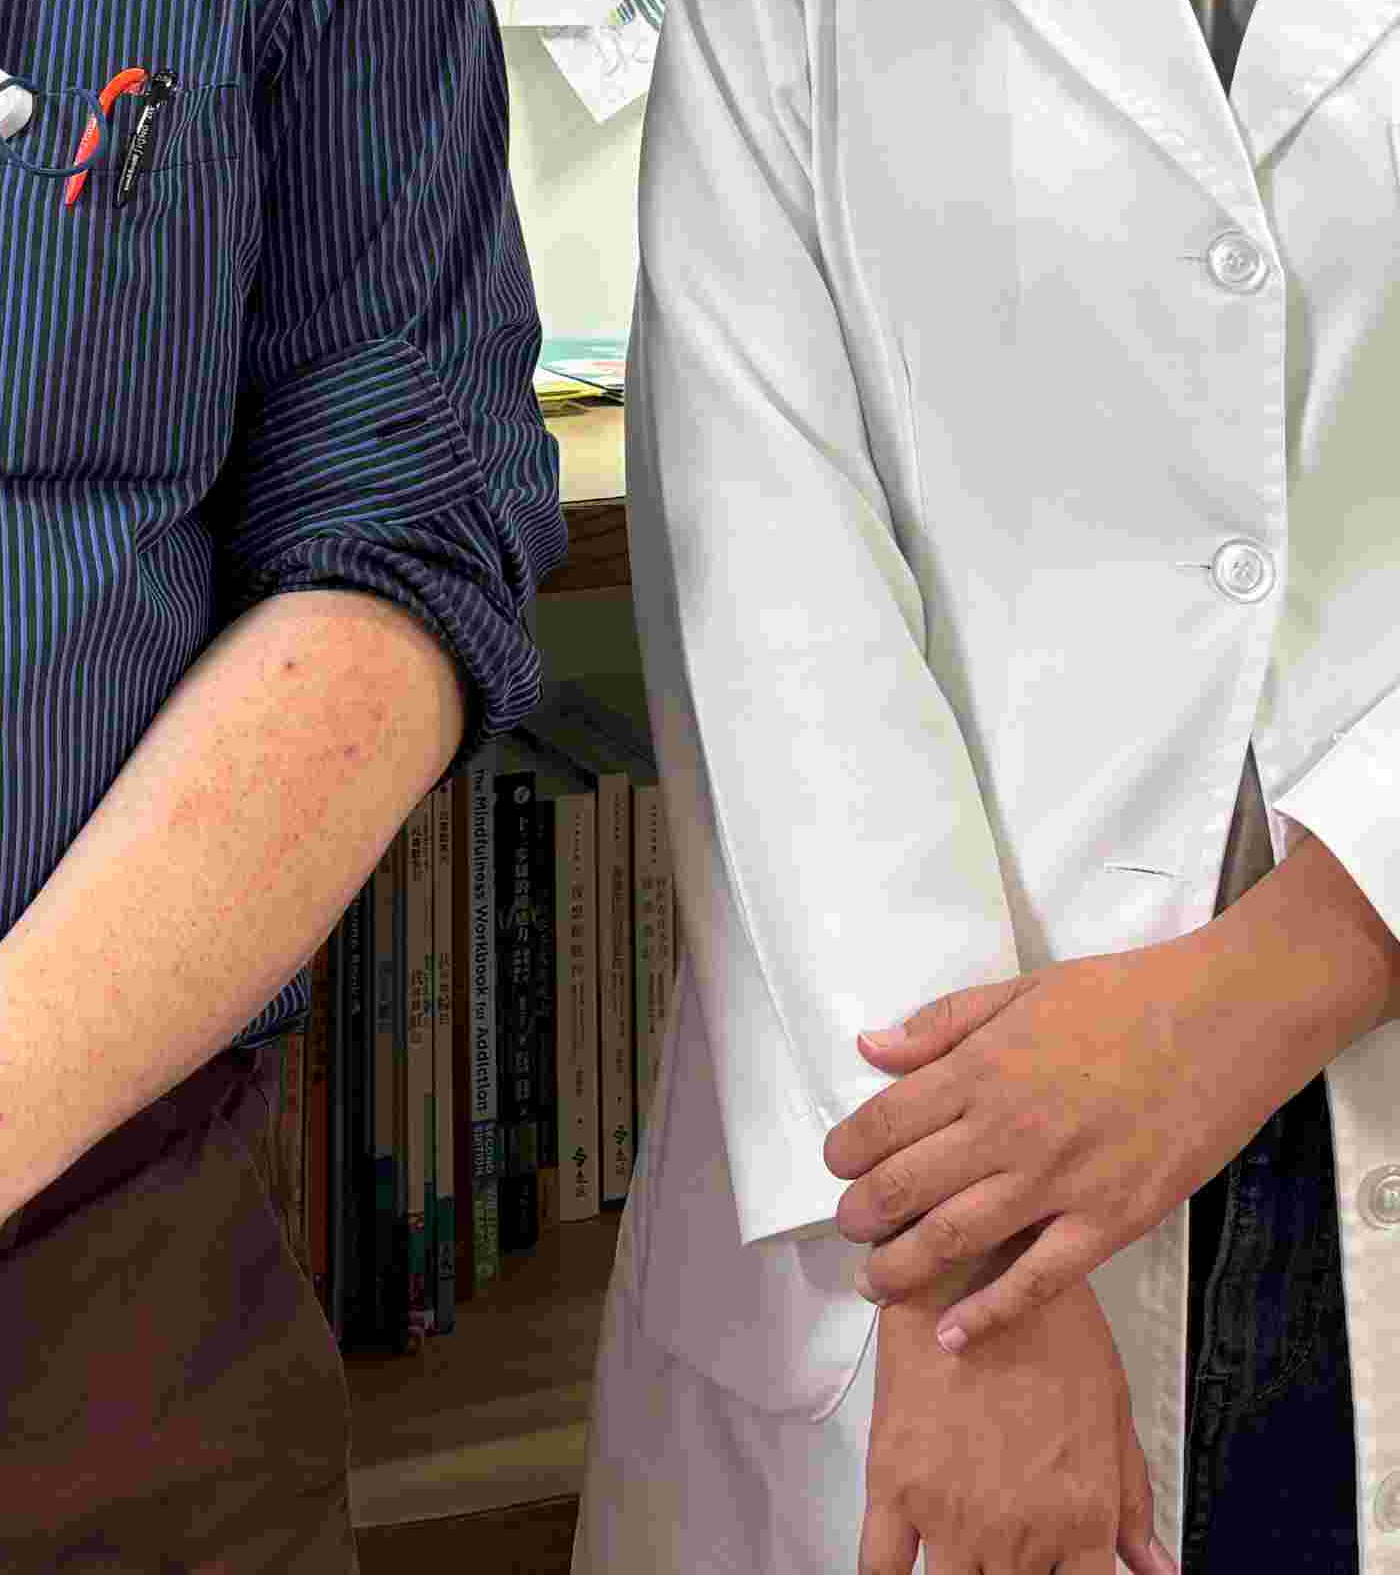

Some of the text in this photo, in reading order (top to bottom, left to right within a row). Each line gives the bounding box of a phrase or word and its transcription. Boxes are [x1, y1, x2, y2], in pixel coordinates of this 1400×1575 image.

[472, 796, 489, 900] Mindfulness
[473, 905, 490, 995] Workbook
[474, 1027, 489, 1113] Addiction
